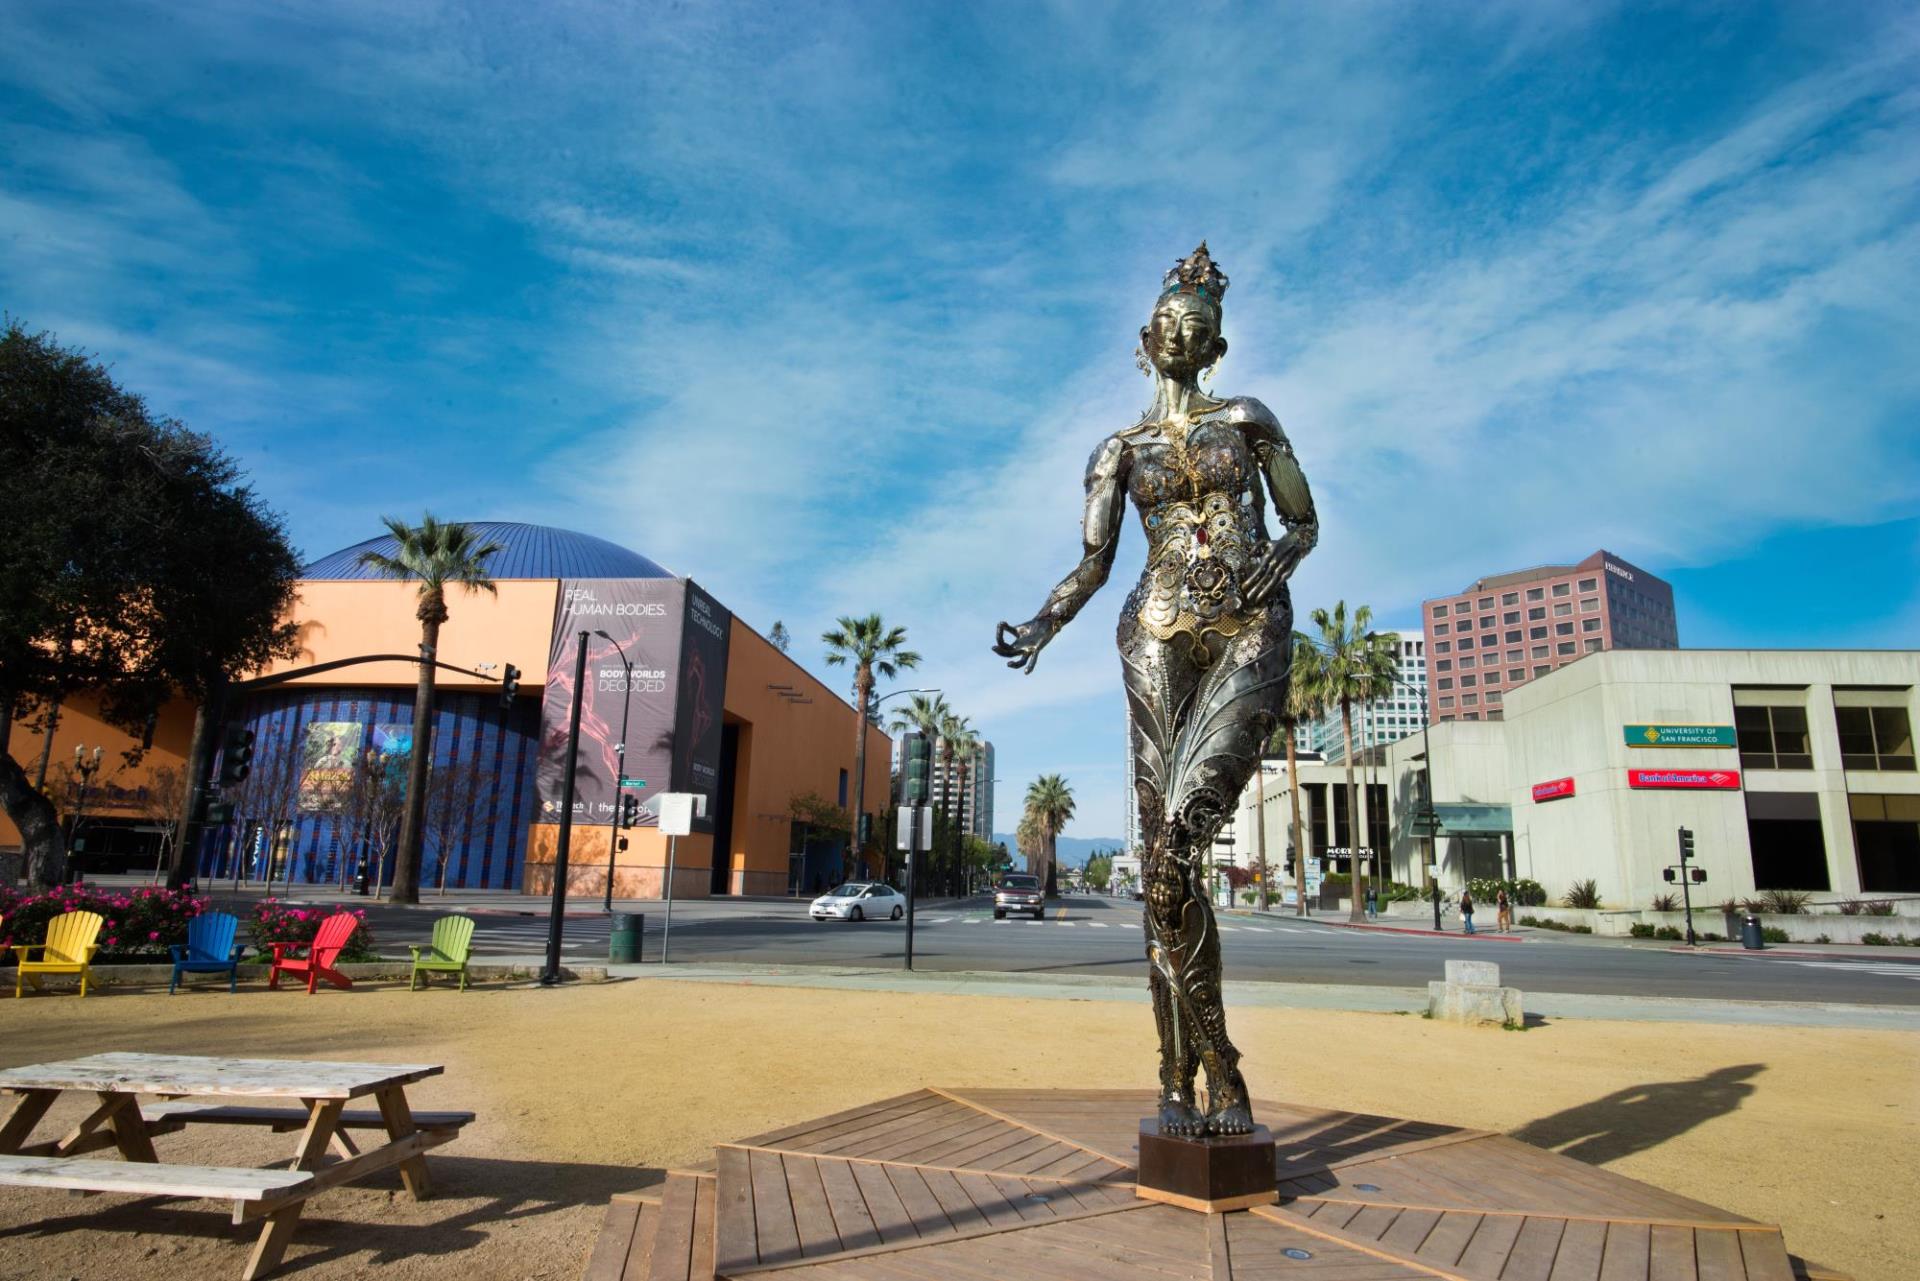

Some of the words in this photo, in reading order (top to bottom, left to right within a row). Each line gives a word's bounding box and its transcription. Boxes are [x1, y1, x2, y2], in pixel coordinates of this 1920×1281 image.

[564, 589, 598, 601] REAL
[561, 603, 613, 616] HUMAN
[600, 669, 624, 679] BODY
[627, 670, 666, 679] WORLDS
[599, 679, 665, 693] DECODED
[1660, 735, 1676, 743] SAN
[1678, 735, 1718, 743] FRANCISCO
[1639, 773, 1660, 783] Bank
[1662, 773, 1671, 783] of
[1671, 773, 1708, 783] America
